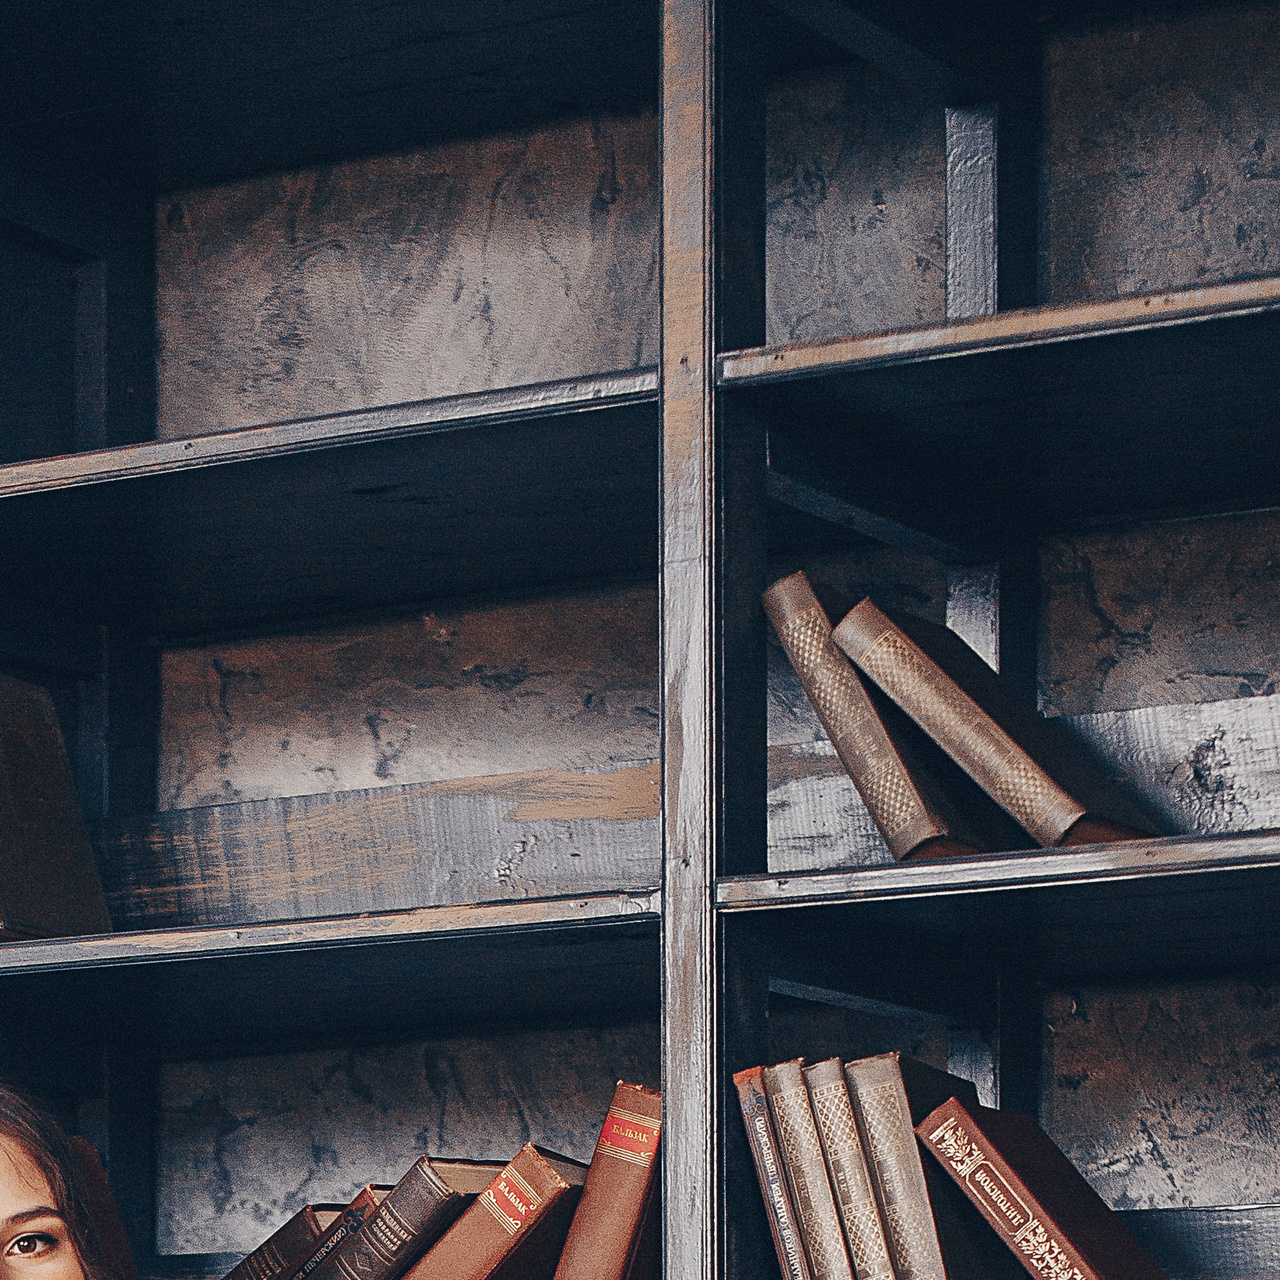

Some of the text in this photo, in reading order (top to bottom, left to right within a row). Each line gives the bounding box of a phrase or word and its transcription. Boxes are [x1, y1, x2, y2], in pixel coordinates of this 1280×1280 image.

[610, 1123, 650, 1143] БАЛЬЗАК
[496, 1180, 530, 1217] БАЛЬЗАК
[972, 1167, 1025, 1228] Л.Н.ТОЛСТОЙ
